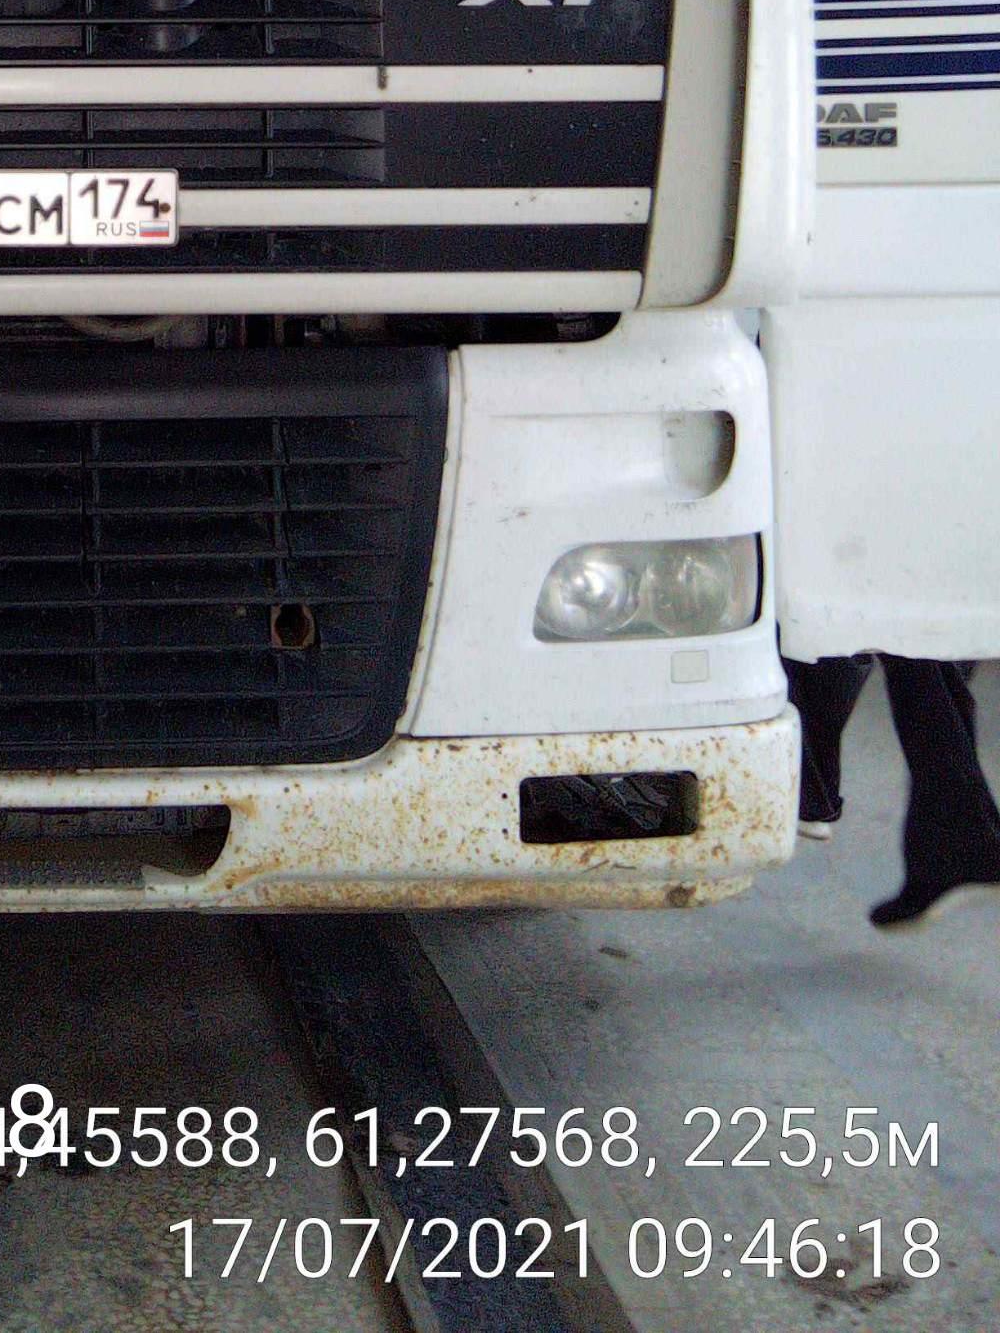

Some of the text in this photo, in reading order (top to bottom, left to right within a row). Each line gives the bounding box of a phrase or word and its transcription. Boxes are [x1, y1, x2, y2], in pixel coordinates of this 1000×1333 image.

[816, 103, 897, 123] AF
[78, 178, 162, 220] 174
[96, 222, 137, 237] RUS
